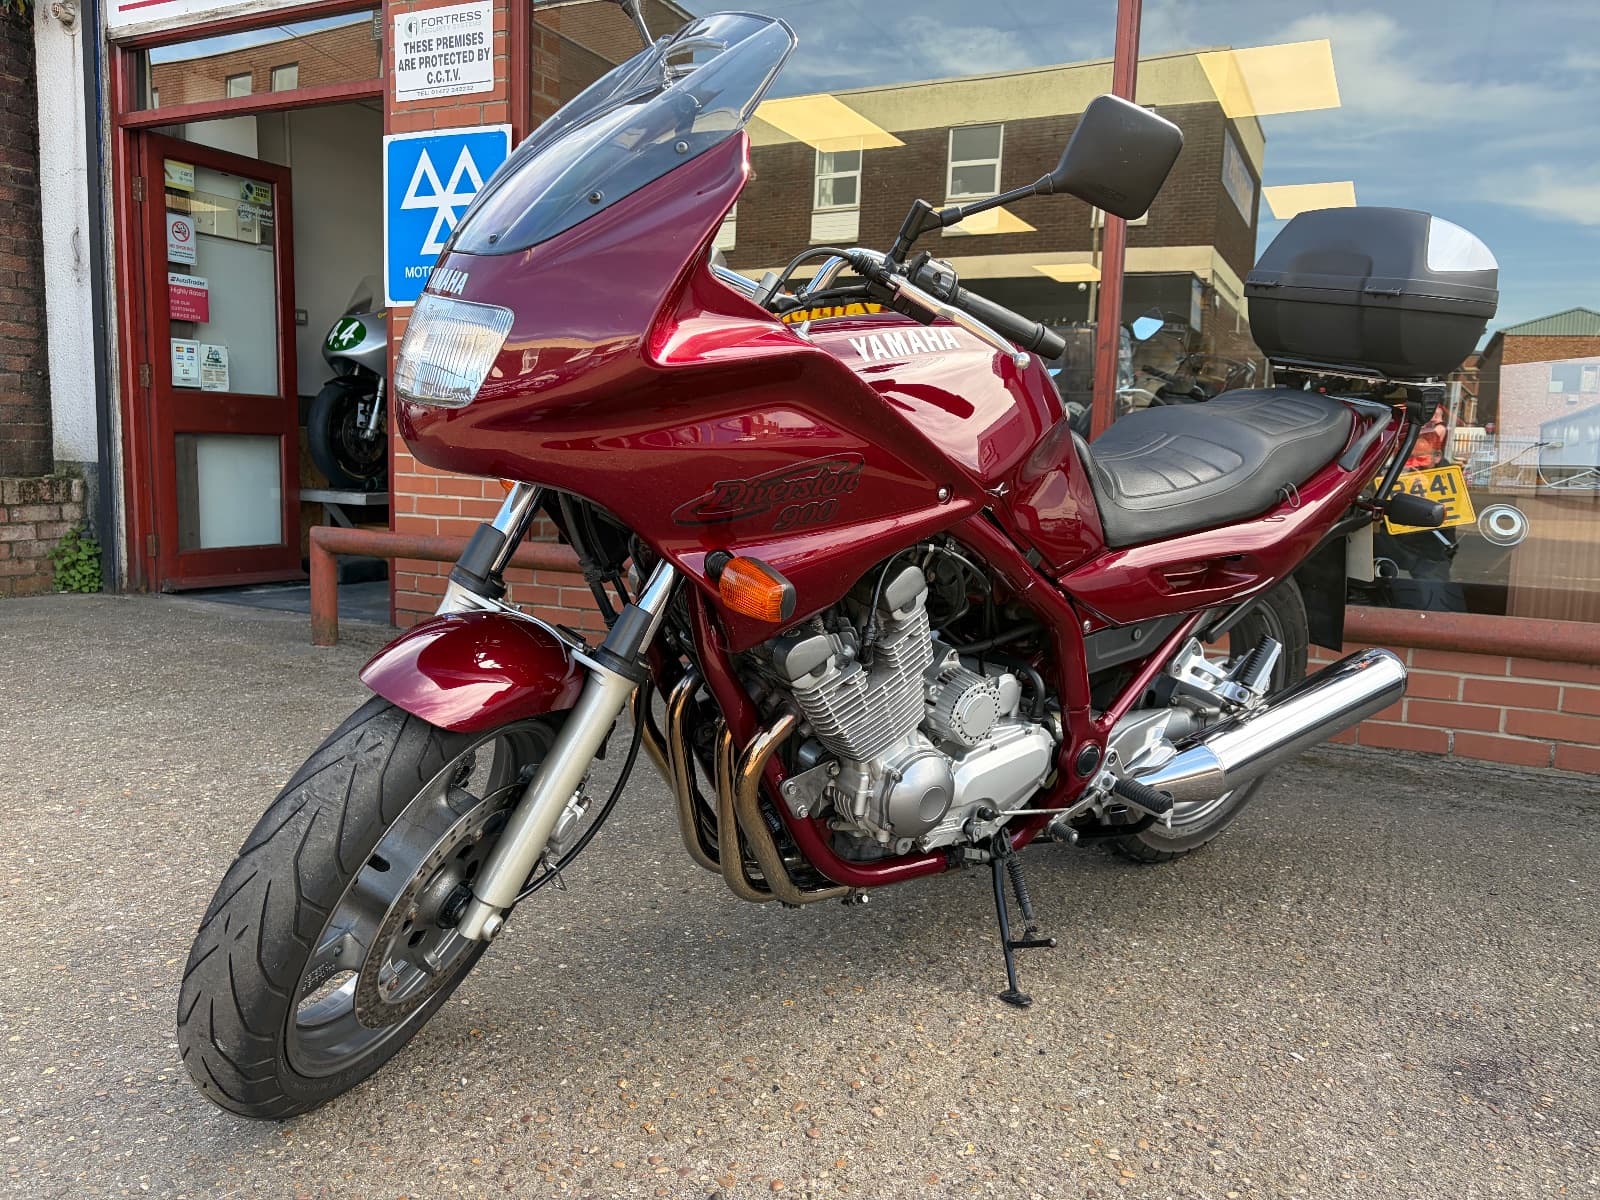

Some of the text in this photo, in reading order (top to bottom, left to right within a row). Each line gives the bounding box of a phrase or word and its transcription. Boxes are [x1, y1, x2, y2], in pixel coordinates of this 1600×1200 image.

[421, 10, 482, 28] FORTRESS
[404, 32, 484, 55] THESE PREMISES
[398, 47, 490, 72] ARE PROTECTED BY
[427, 68, 461, 85] C.C.T.V.
[848, 326, 961, 362] YAMAHA
[702, 462, 864, 509] Diversion
[772, 499, 840, 531] 900
